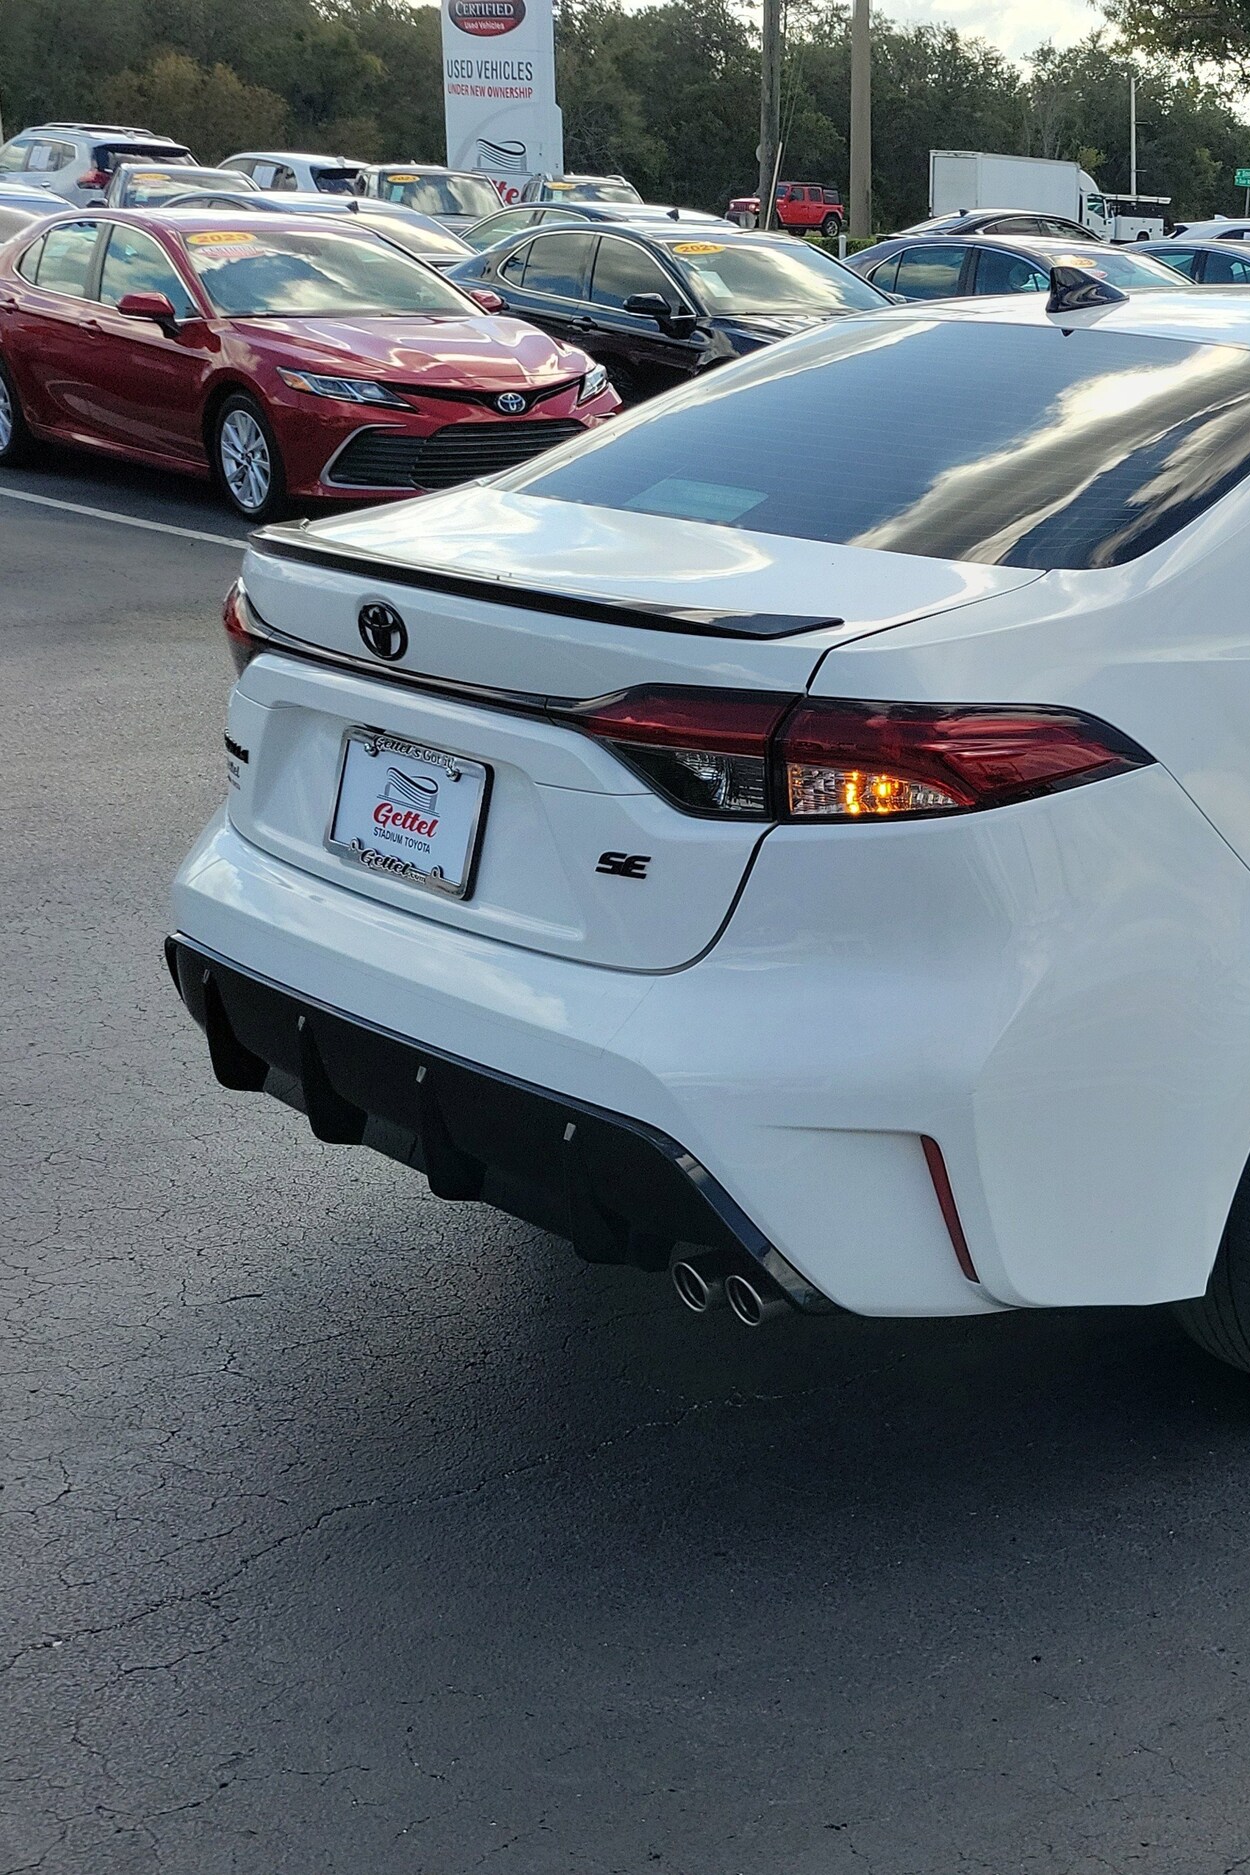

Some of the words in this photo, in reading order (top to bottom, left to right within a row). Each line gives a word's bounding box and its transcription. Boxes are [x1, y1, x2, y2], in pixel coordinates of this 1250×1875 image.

[455, 0, 514, 17] CERTIFIED
[446, 60, 473, 79] USED
[476, 60, 533, 81] VEHICLES
[448, 83, 469, 95] UNDER
[470, 85, 486, 97] NEW
[487, 86, 533, 98] OWNERSHIP
[373, 802, 439, 838] Gettel
[373, 826, 403, 846] STADIUM
[404, 836, 432, 854] TOYOTA
[595, 851, 652, 880] SE
